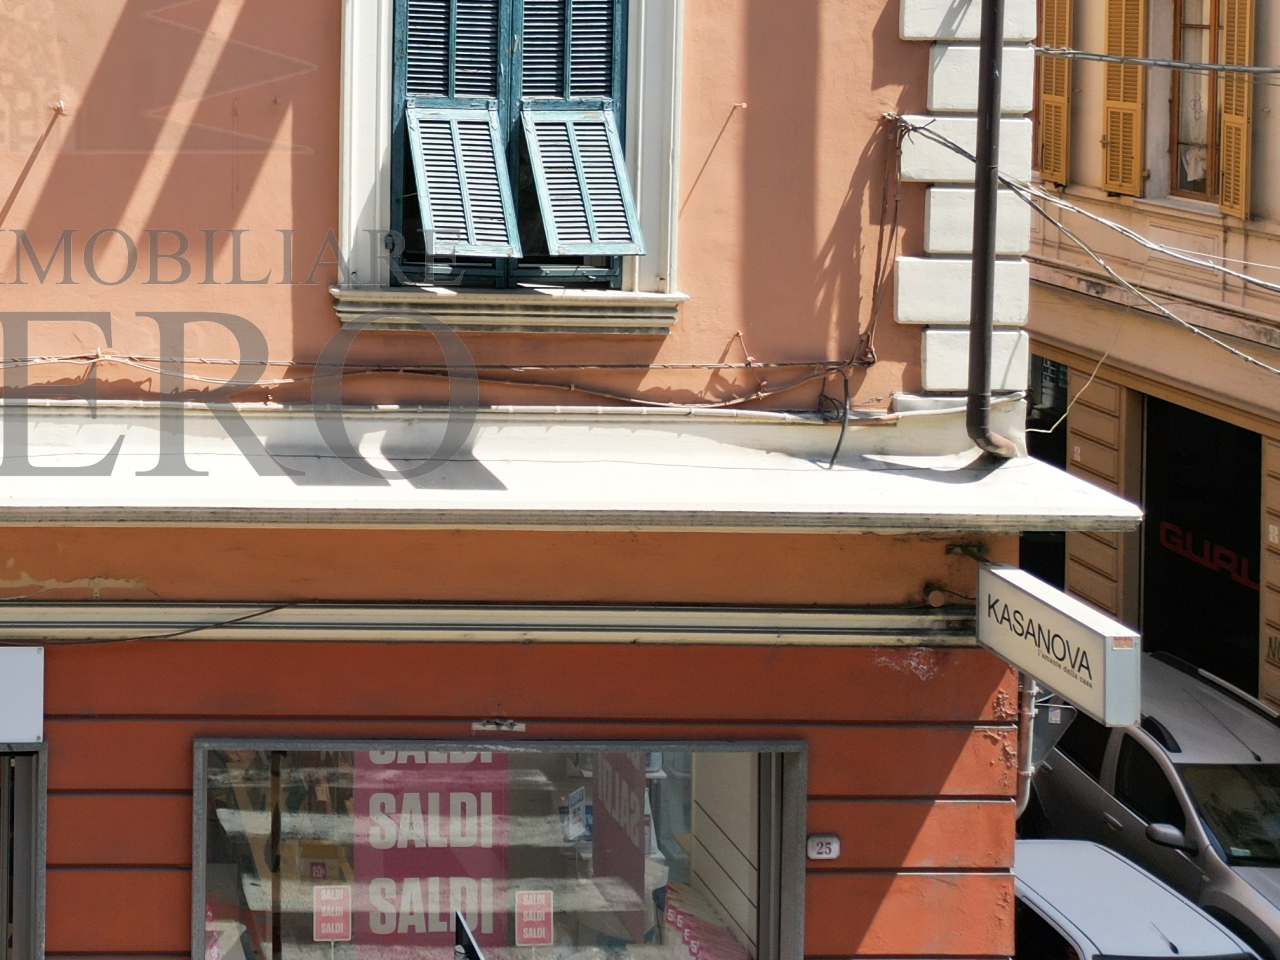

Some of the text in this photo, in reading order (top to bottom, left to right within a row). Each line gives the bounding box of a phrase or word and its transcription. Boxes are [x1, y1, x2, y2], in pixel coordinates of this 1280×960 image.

[987, 593, 1093, 681] KASANOVA
[368, 792, 493, 850] SALDI
[816, 841, 832, 856] 25
[320, 889, 344, 901] SALDI
[523, 894, 546, 905] SALDI
[321, 905, 344, 917] SALDI
[368, 876, 494, 935] SALDI
[523, 910, 546, 922] SALDI
[321, 922, 344, 934] SALDI
[523, 927, 546, 939] SALDI
